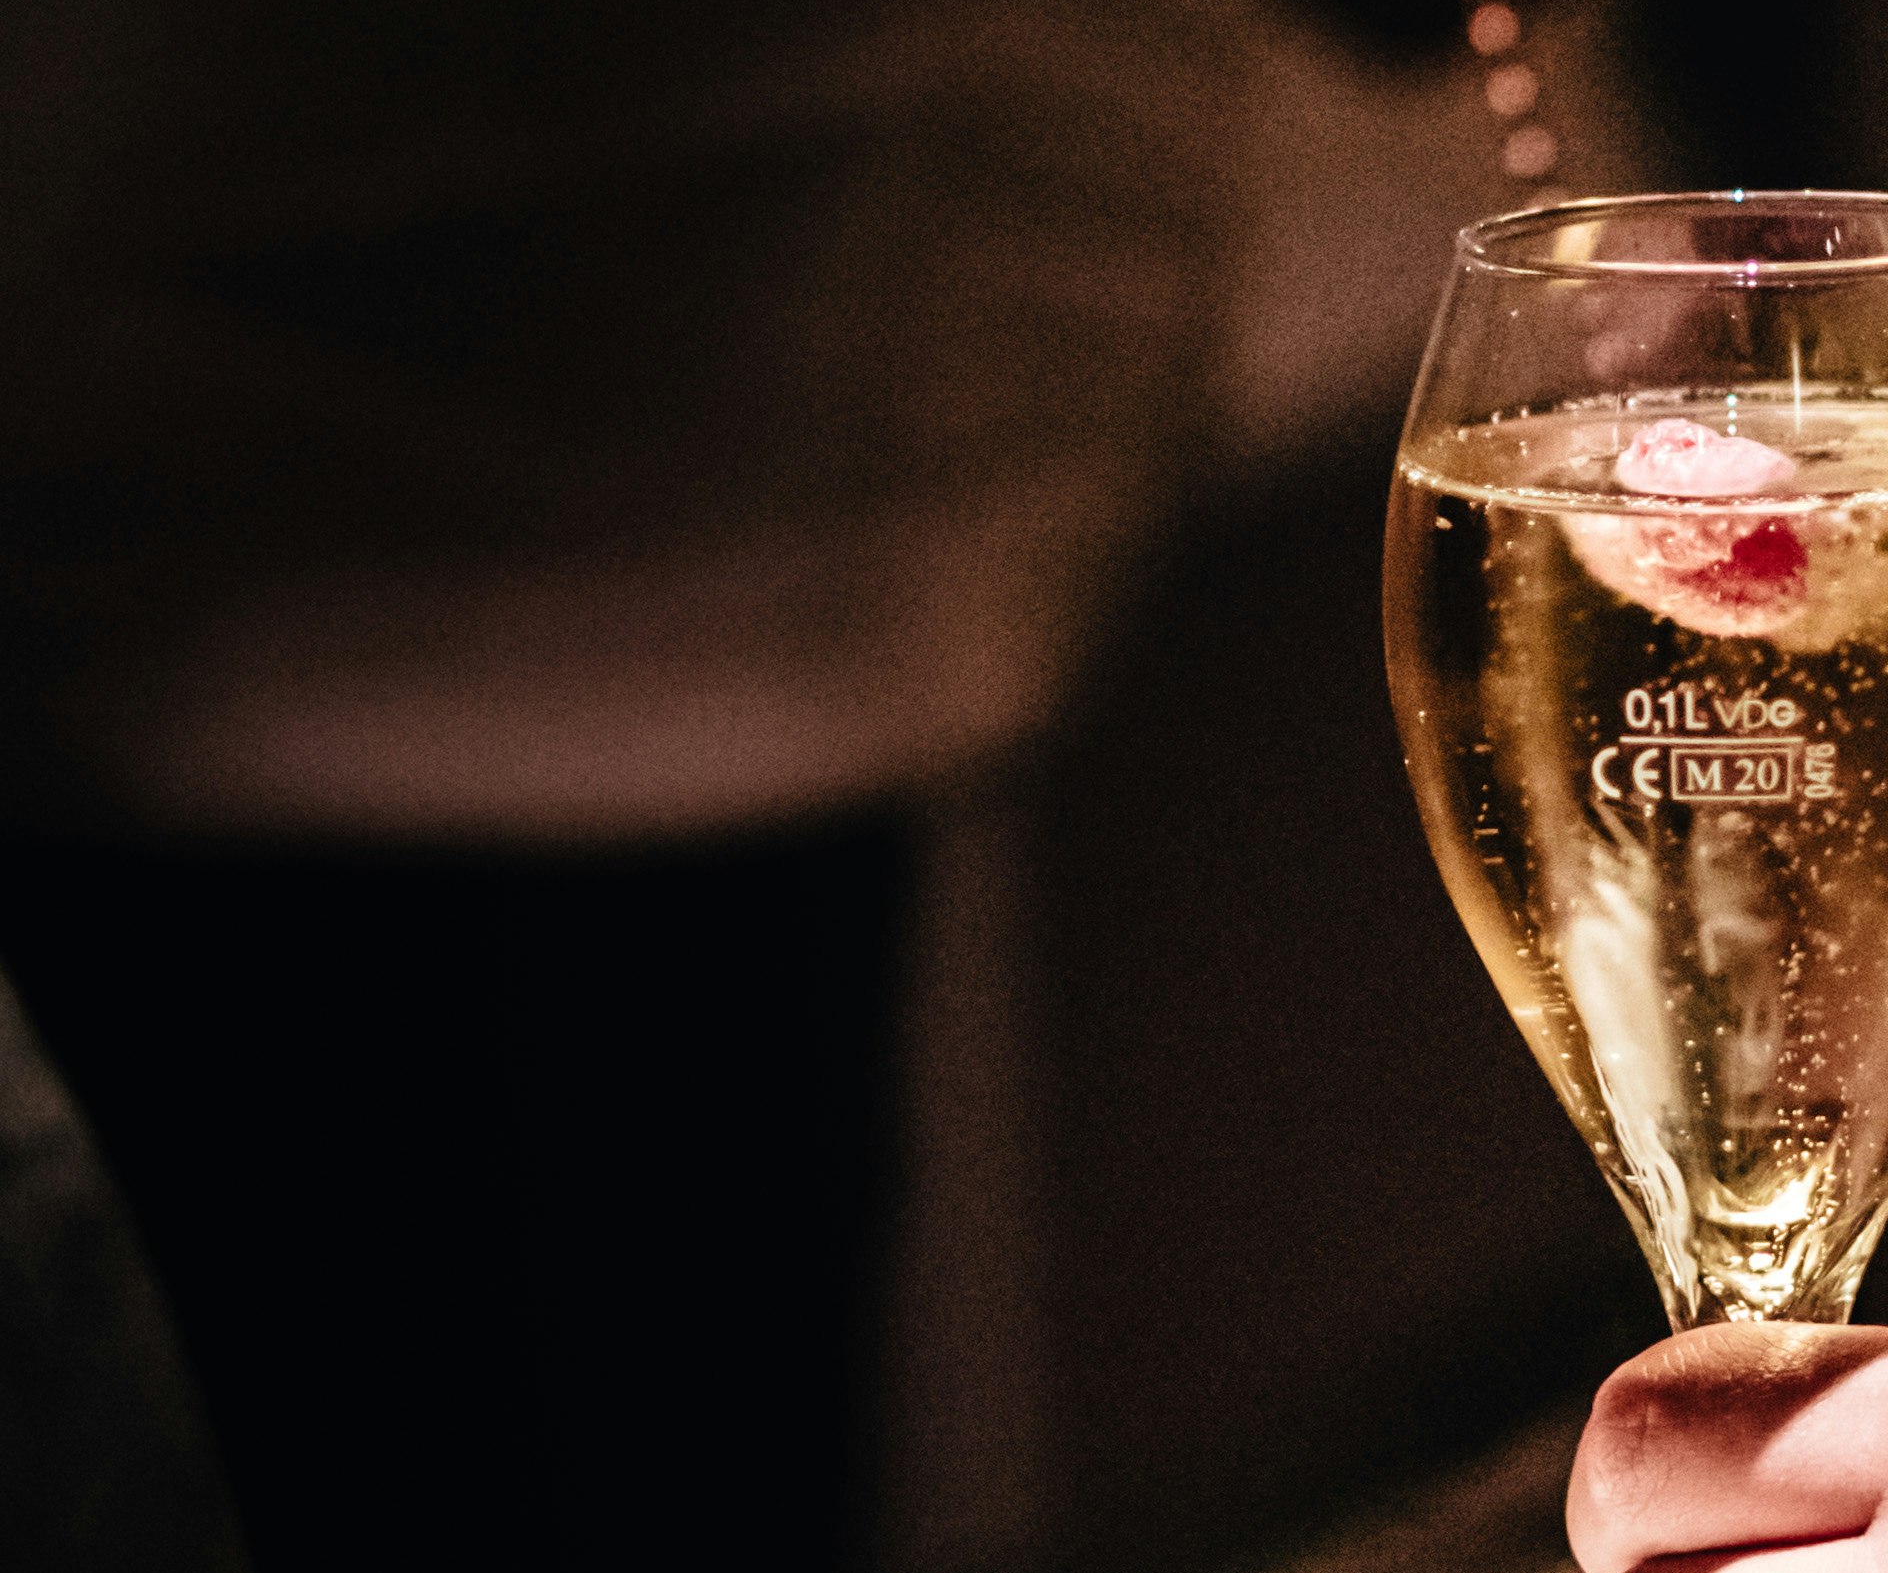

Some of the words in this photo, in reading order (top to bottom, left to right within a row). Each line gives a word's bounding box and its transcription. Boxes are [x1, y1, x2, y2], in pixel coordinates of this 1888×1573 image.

[1713, 697, 1797, 729] VDG
[1592, 746, 1662, 799] CE
[1685, 758, 1721, 791] M
[1734, 758, 1779, 790] 20
